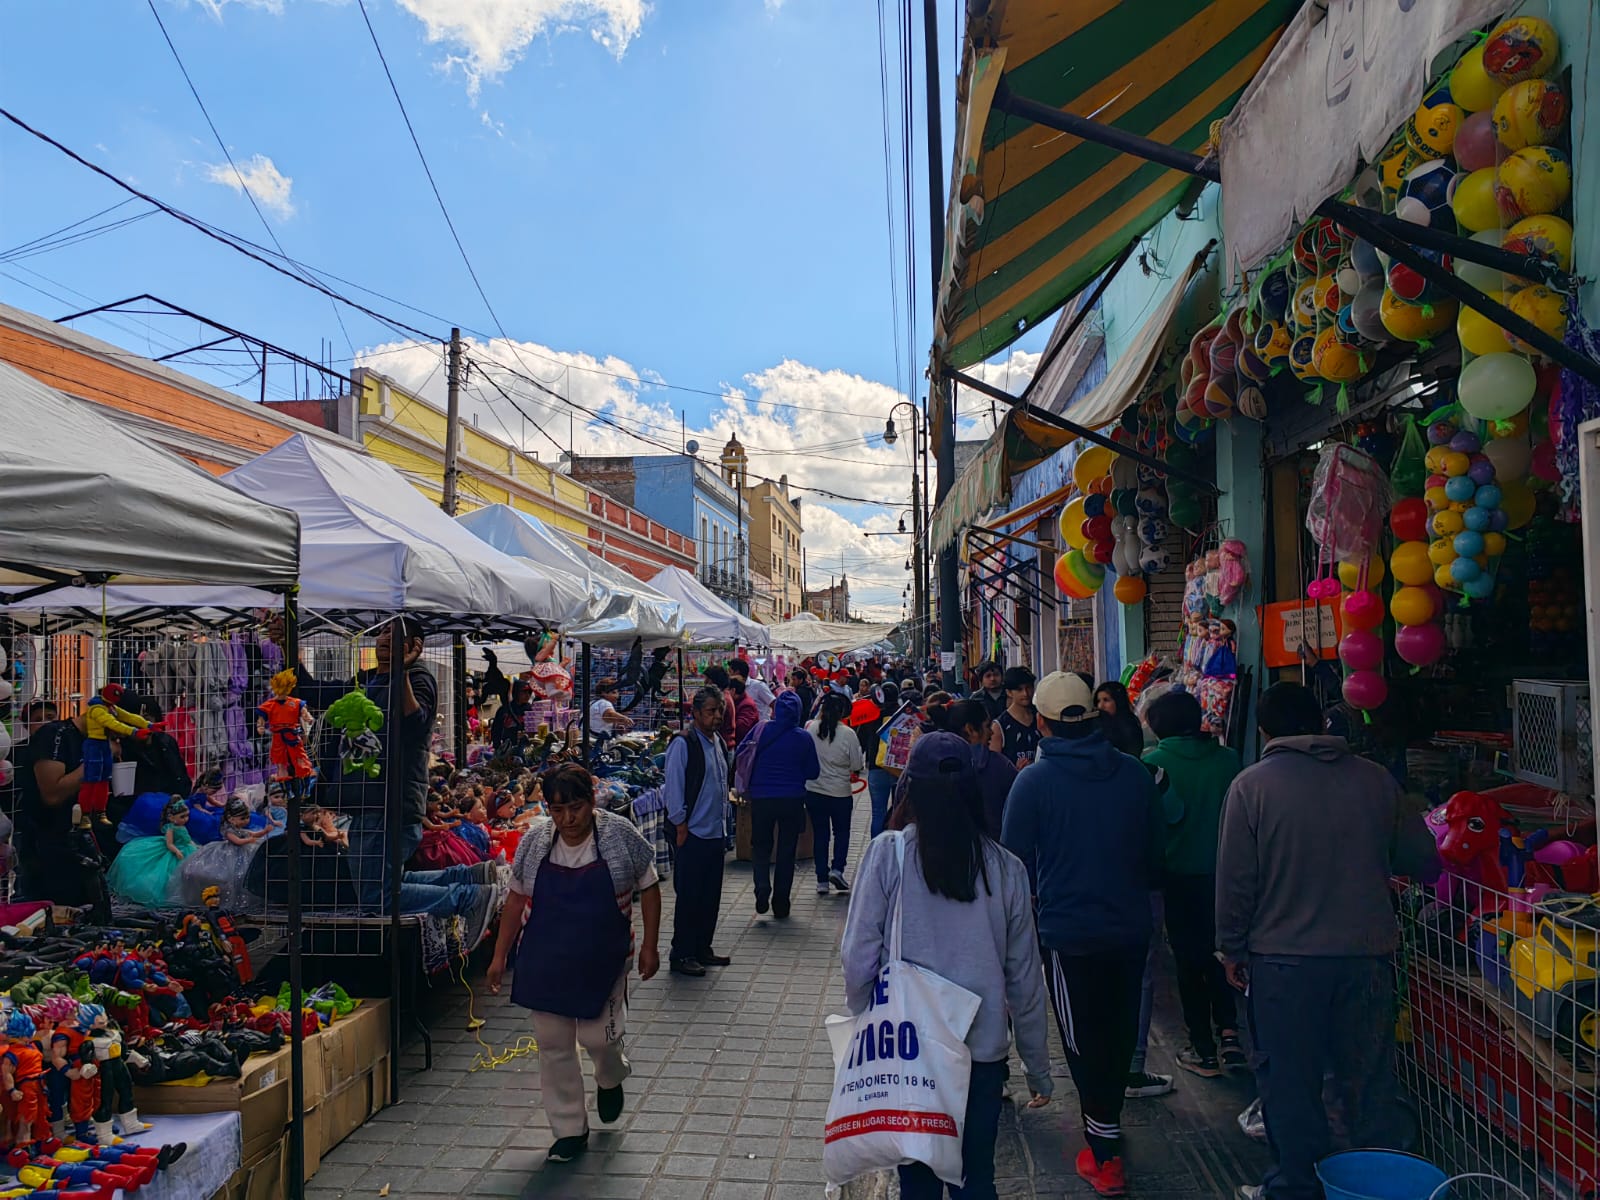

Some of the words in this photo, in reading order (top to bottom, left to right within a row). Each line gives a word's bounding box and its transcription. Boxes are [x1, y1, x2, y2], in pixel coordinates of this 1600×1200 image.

[874, 1074, 900, 1085] NETO
[904, 1076, 918, 1086] 18
[922, 1076, 936, 1090] kg
[862, 1115, 886, 1128] LUGAR
[886, 1115, 910, 1126] SECO
[911, 1117, 919, 1127] Y
